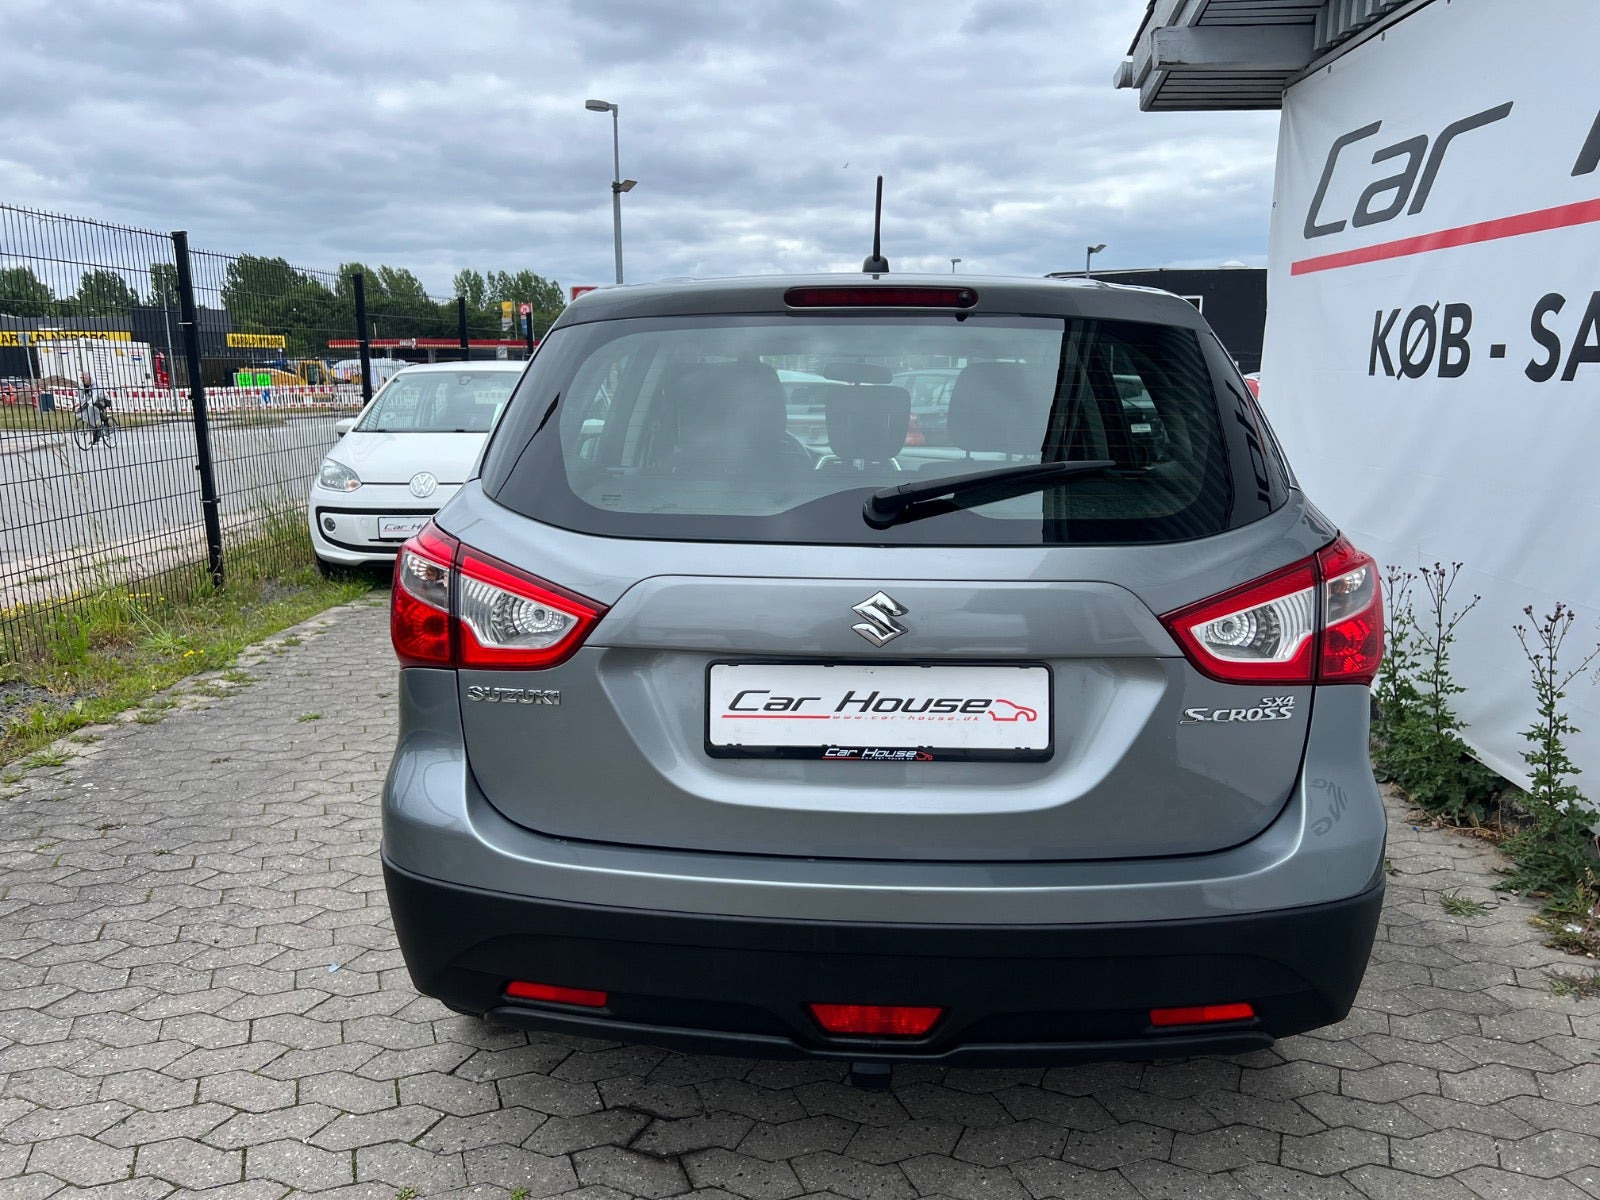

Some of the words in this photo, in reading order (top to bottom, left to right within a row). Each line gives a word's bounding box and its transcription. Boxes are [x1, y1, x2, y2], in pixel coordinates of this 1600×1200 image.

[1304, 101, 1513, 239] Car
[1369, 300, 1472, 380] KØB
[467, 685, 561, 705] SUZUKI
[728, 690, 822, 711] Car
[834, 691, 993, 713] House
[1259, 695, 1295, 707] SX4
[825, 748, 858, 756] Car
[862, 748, 917, 757] House
